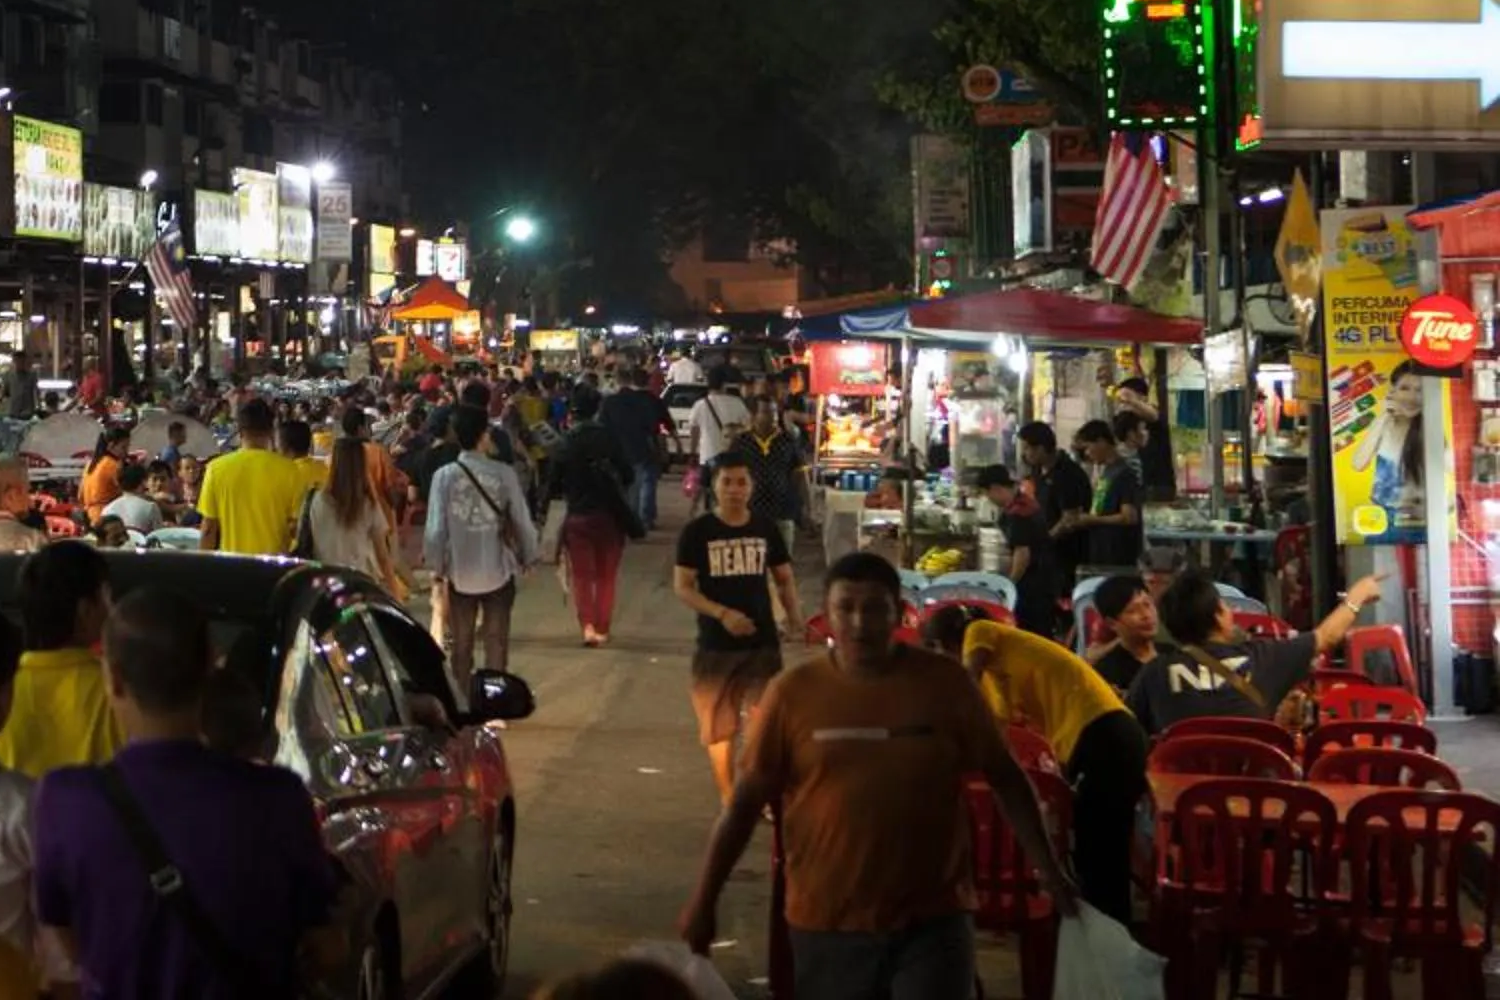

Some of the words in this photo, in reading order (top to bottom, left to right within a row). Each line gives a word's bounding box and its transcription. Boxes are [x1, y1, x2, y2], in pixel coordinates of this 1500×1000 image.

[1332, 296, 1411, 310] PERCUMA
[1333, 310, 1404, 325] INTERNE
[1334, 325, 1363, 343] 4G
[1369, 325, 1400, 343] PL
[1411, 312, 1474, 344] Tune
[708, 546, 765, 577] HEART
